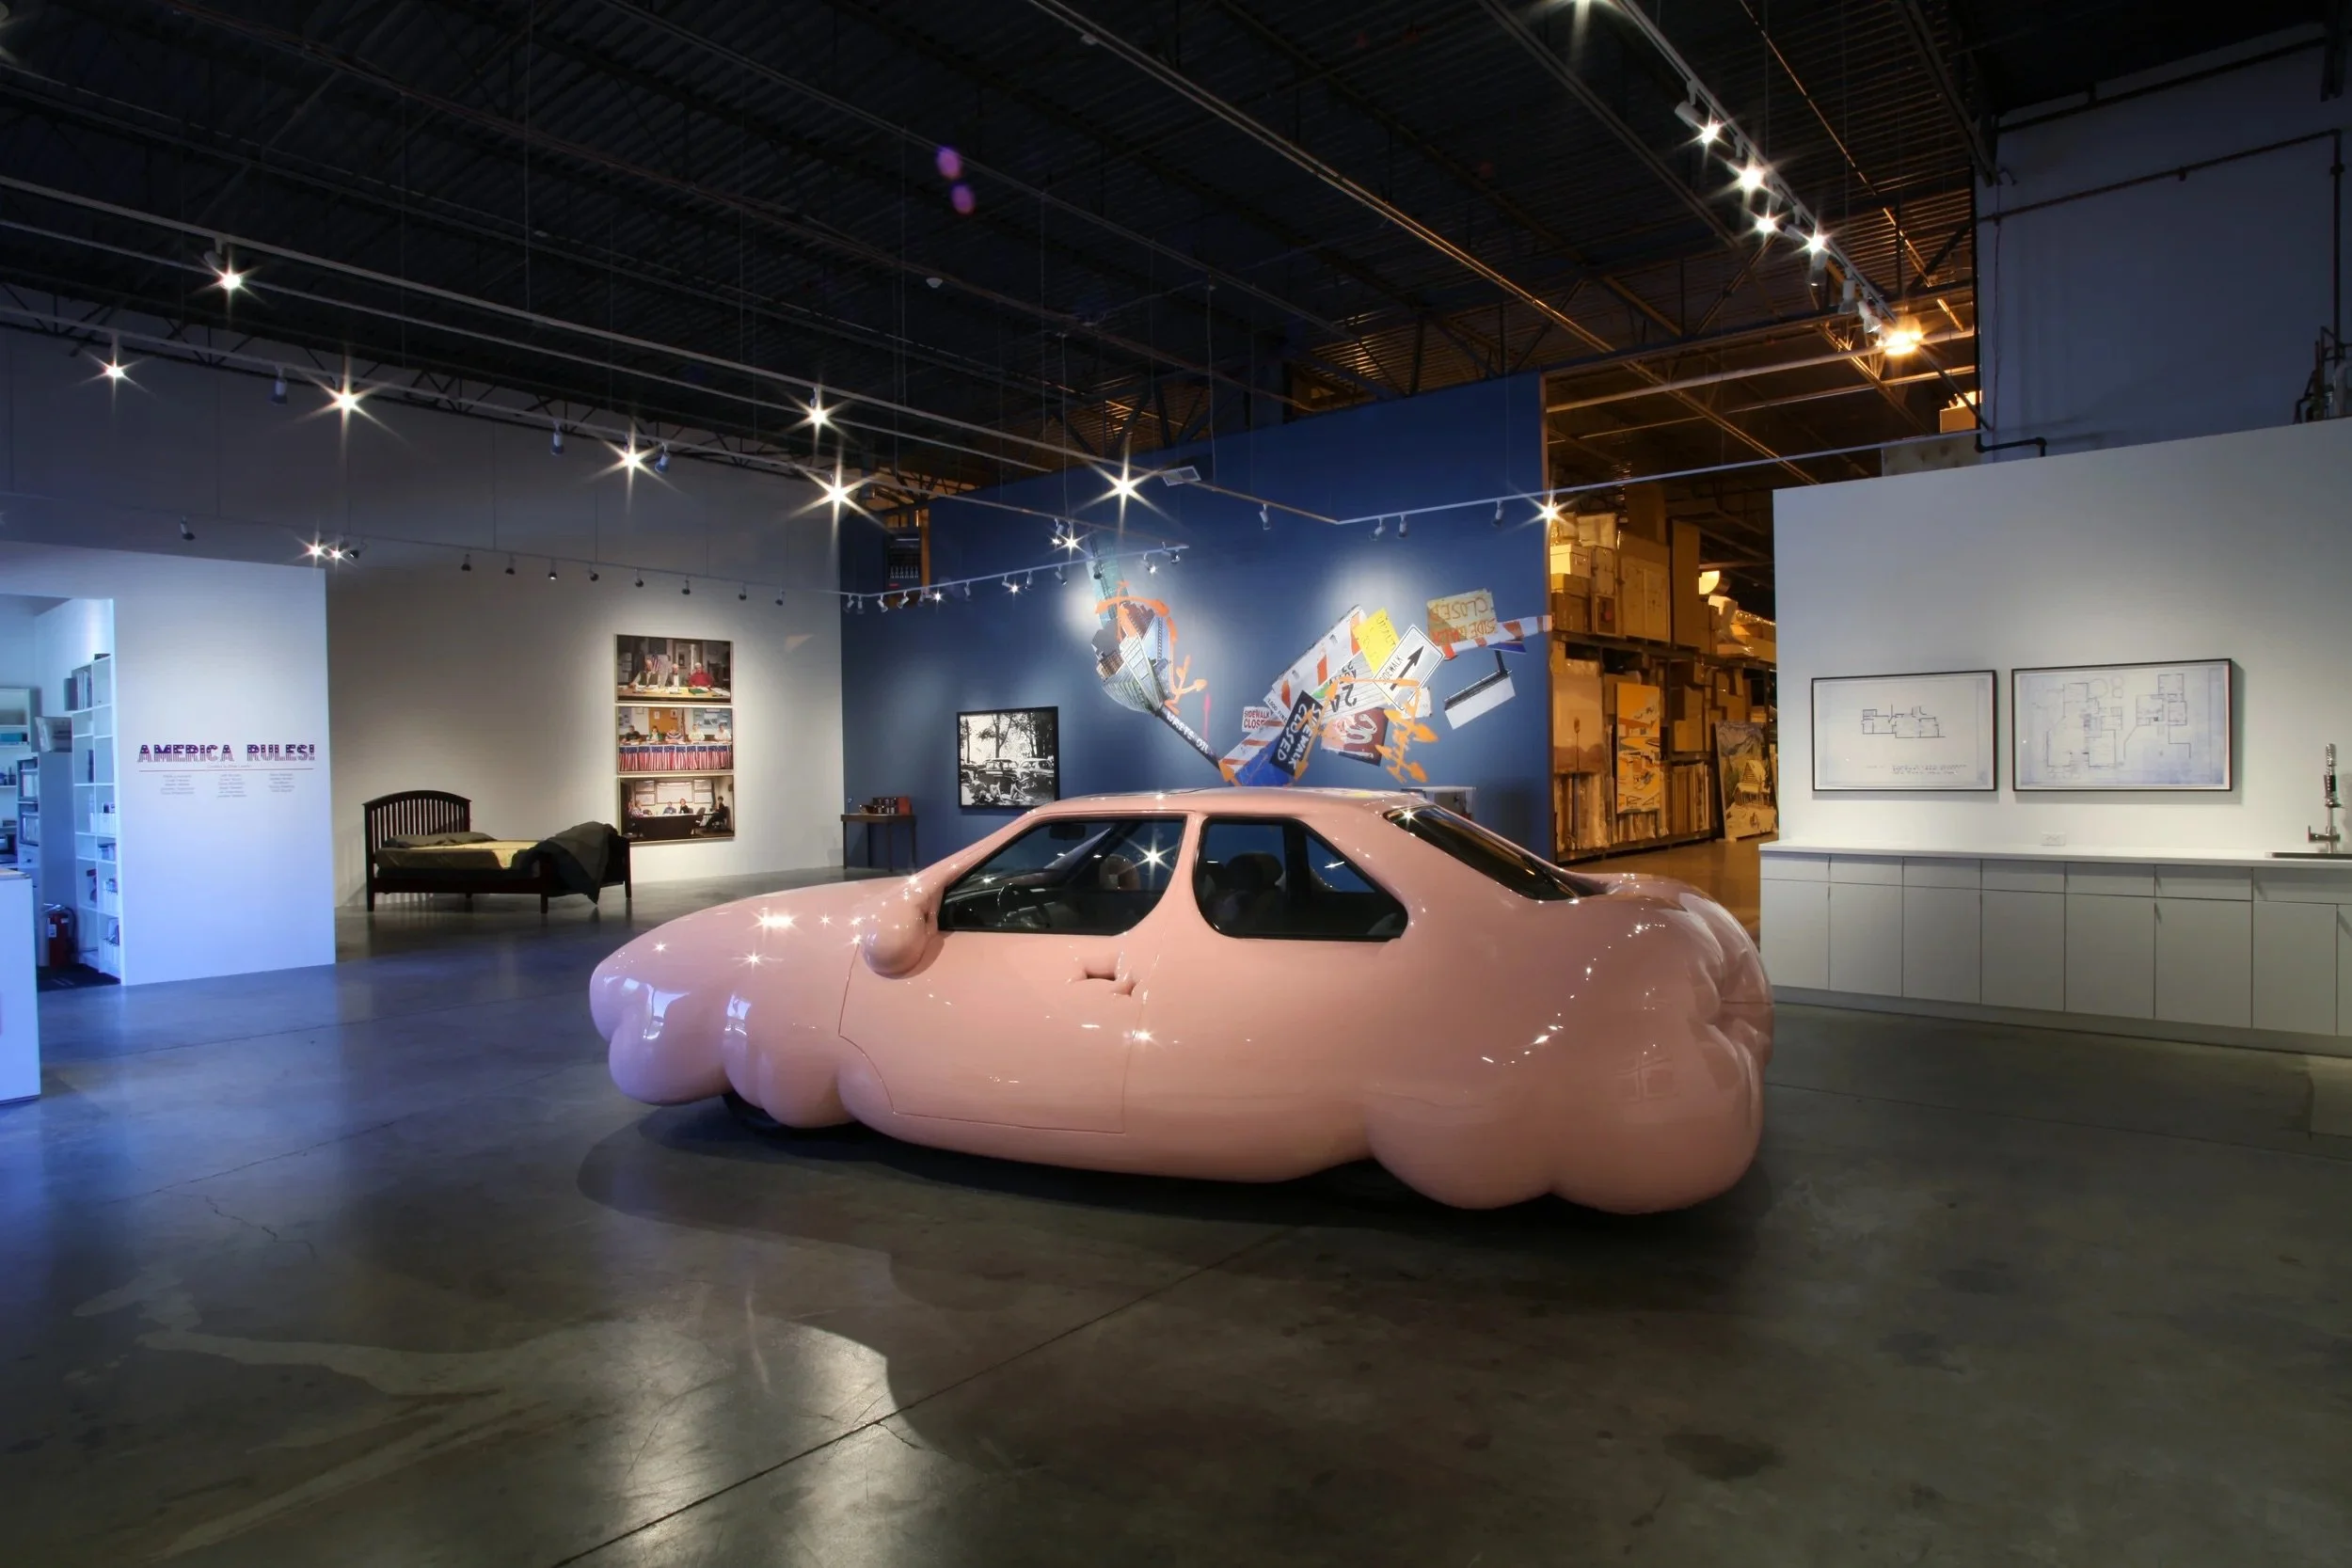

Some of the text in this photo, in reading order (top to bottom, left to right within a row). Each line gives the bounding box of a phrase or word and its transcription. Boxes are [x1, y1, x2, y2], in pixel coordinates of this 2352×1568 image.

[1244, 710, 1270, 719] SIDEWALK
[1278, 704, 1307, 761] CLOSED
[137, 744, 315, 762] AMERICA RULES!
